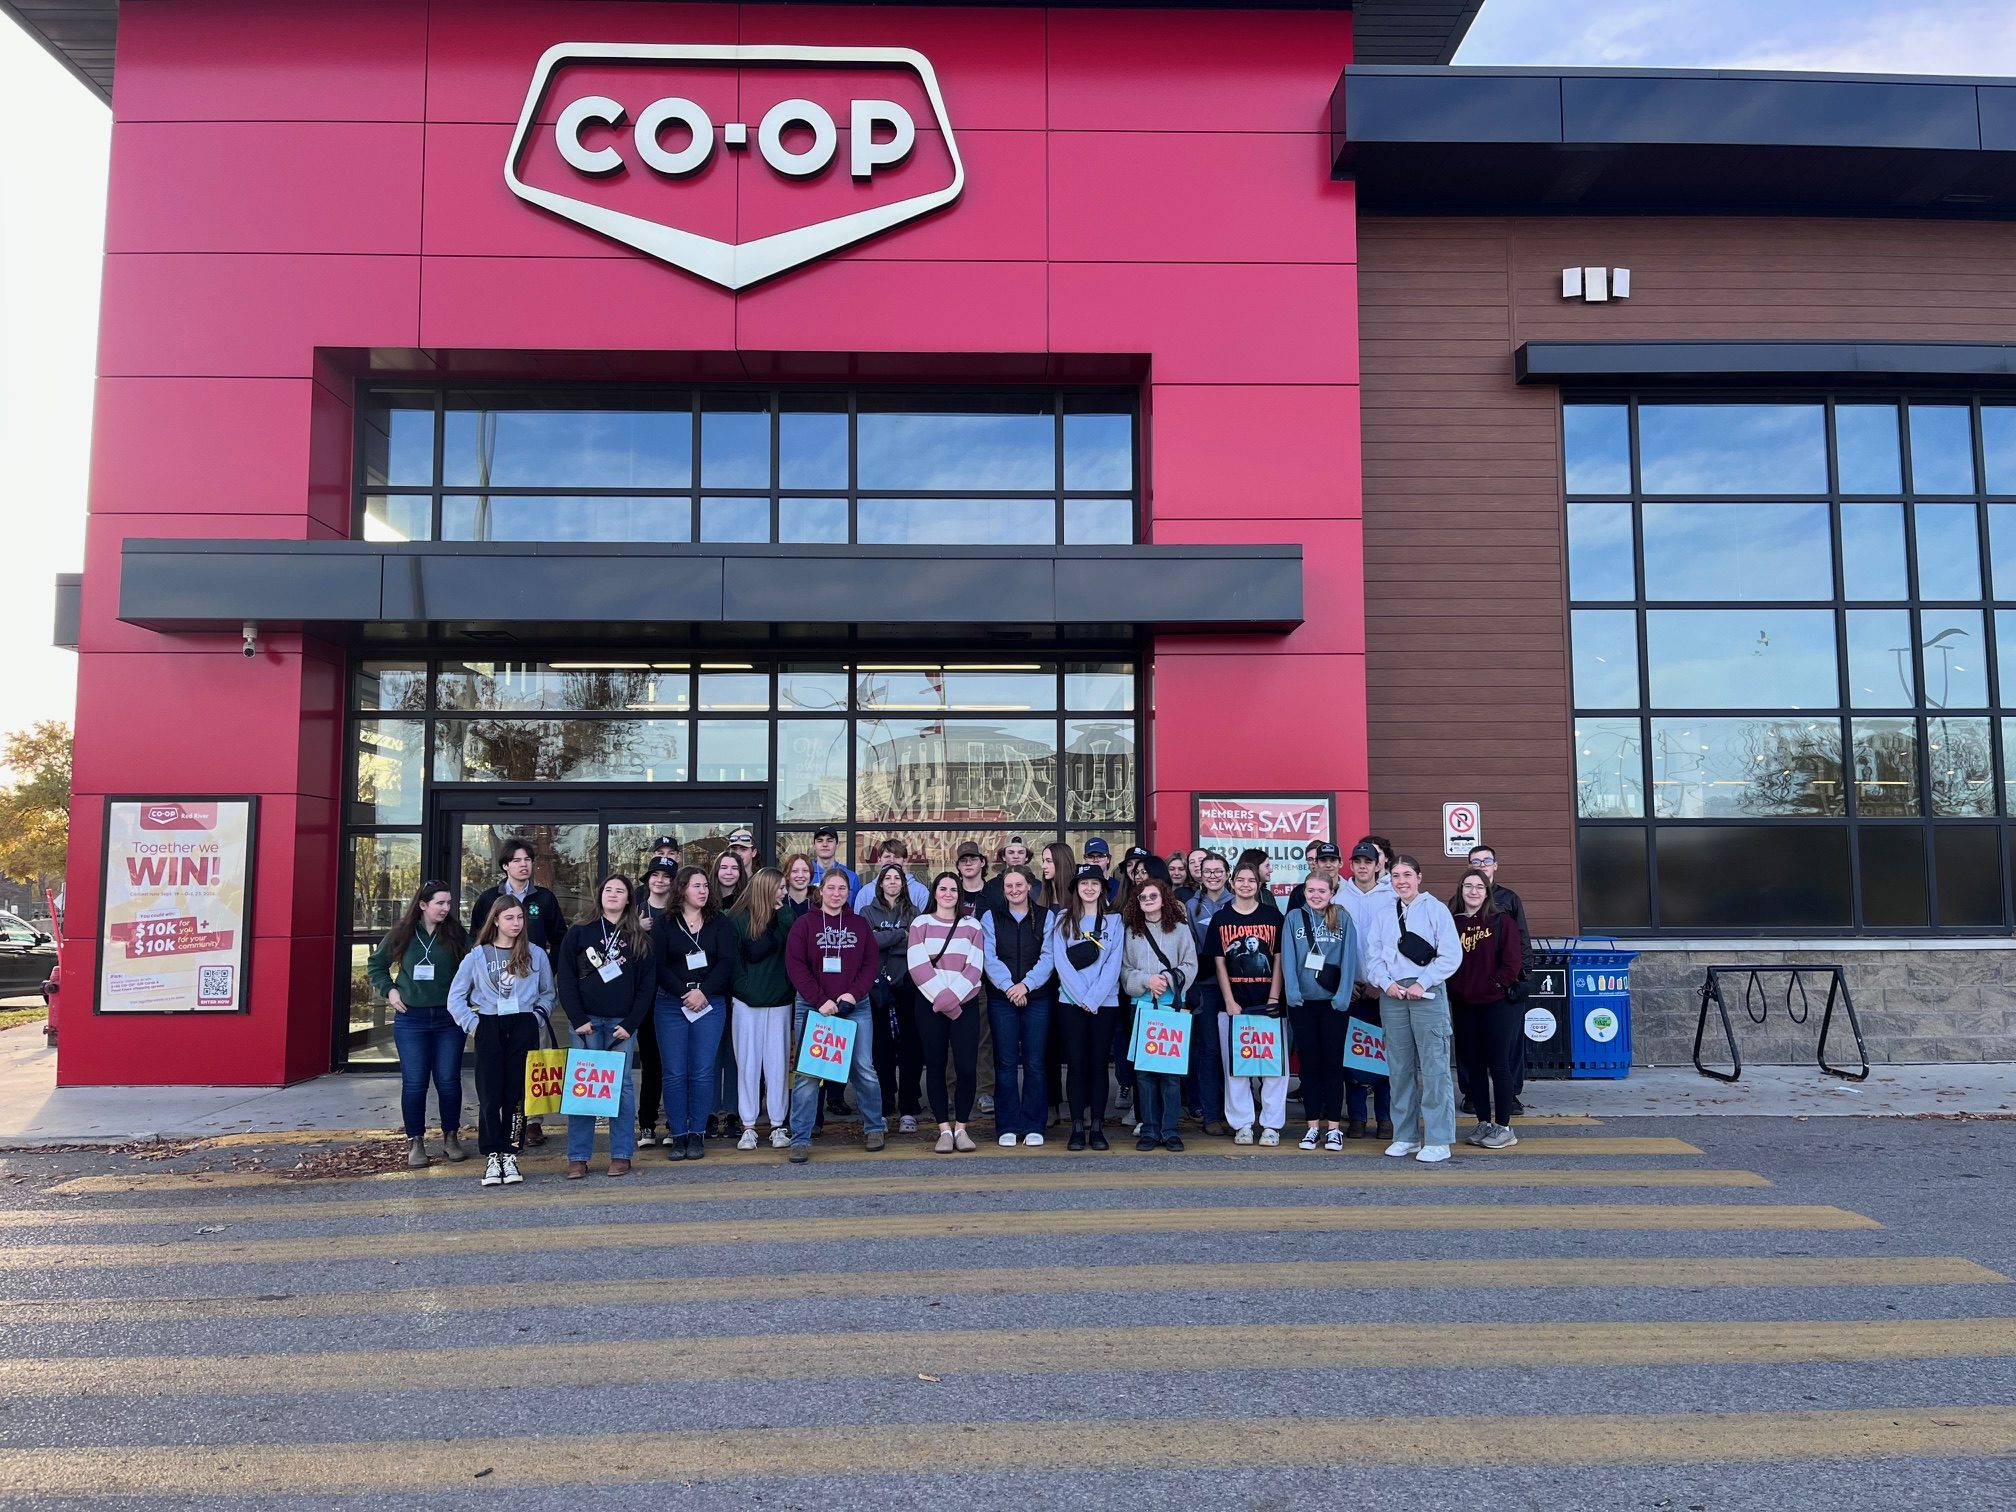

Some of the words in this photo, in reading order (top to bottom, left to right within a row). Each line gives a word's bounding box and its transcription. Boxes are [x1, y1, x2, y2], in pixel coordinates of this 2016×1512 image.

[555, 96, 916, 181] CO-OP
[1201, 809, 1254, 820] MEMBERS
[1258, 811, 1321, 834] SAVE
[1210, 822, 1254, 832] ALWAYS
[131, 841, 196, 855] Together
[199, 843, 219, 853] we
[126, 857, 220, 887] WIN!
[1280, 863, 1307, 871] MEMBE
[135, 922, 178, 939] $10k
[178, 927, 194, 935] you
[815, 931, 858, 946] 2025
[134, 938, 176, 956] $10k
[178, 939, 220, 950] community
[812, 1029, 847, 1050] CAN
[1146, 1026, 1183, 1043] CAN
[1239, 1031, 1274, 1045] CAN
[1351, 1031, 1386, 1051] CAN
[809, 1043, 842, 1064] OLA
[1145, 1041, 1181, 1058] OLA
[1240, 1045, 1274, 1059] OLA
[1351, 1043, 1386, 1062] OLA
[531, 1066, 563, 1083] CAN
[574, 1067, 616, 1084] CAN
[531, 1081, 562, 1098] OLA
[572, 1082, 612, 1099] OLA
